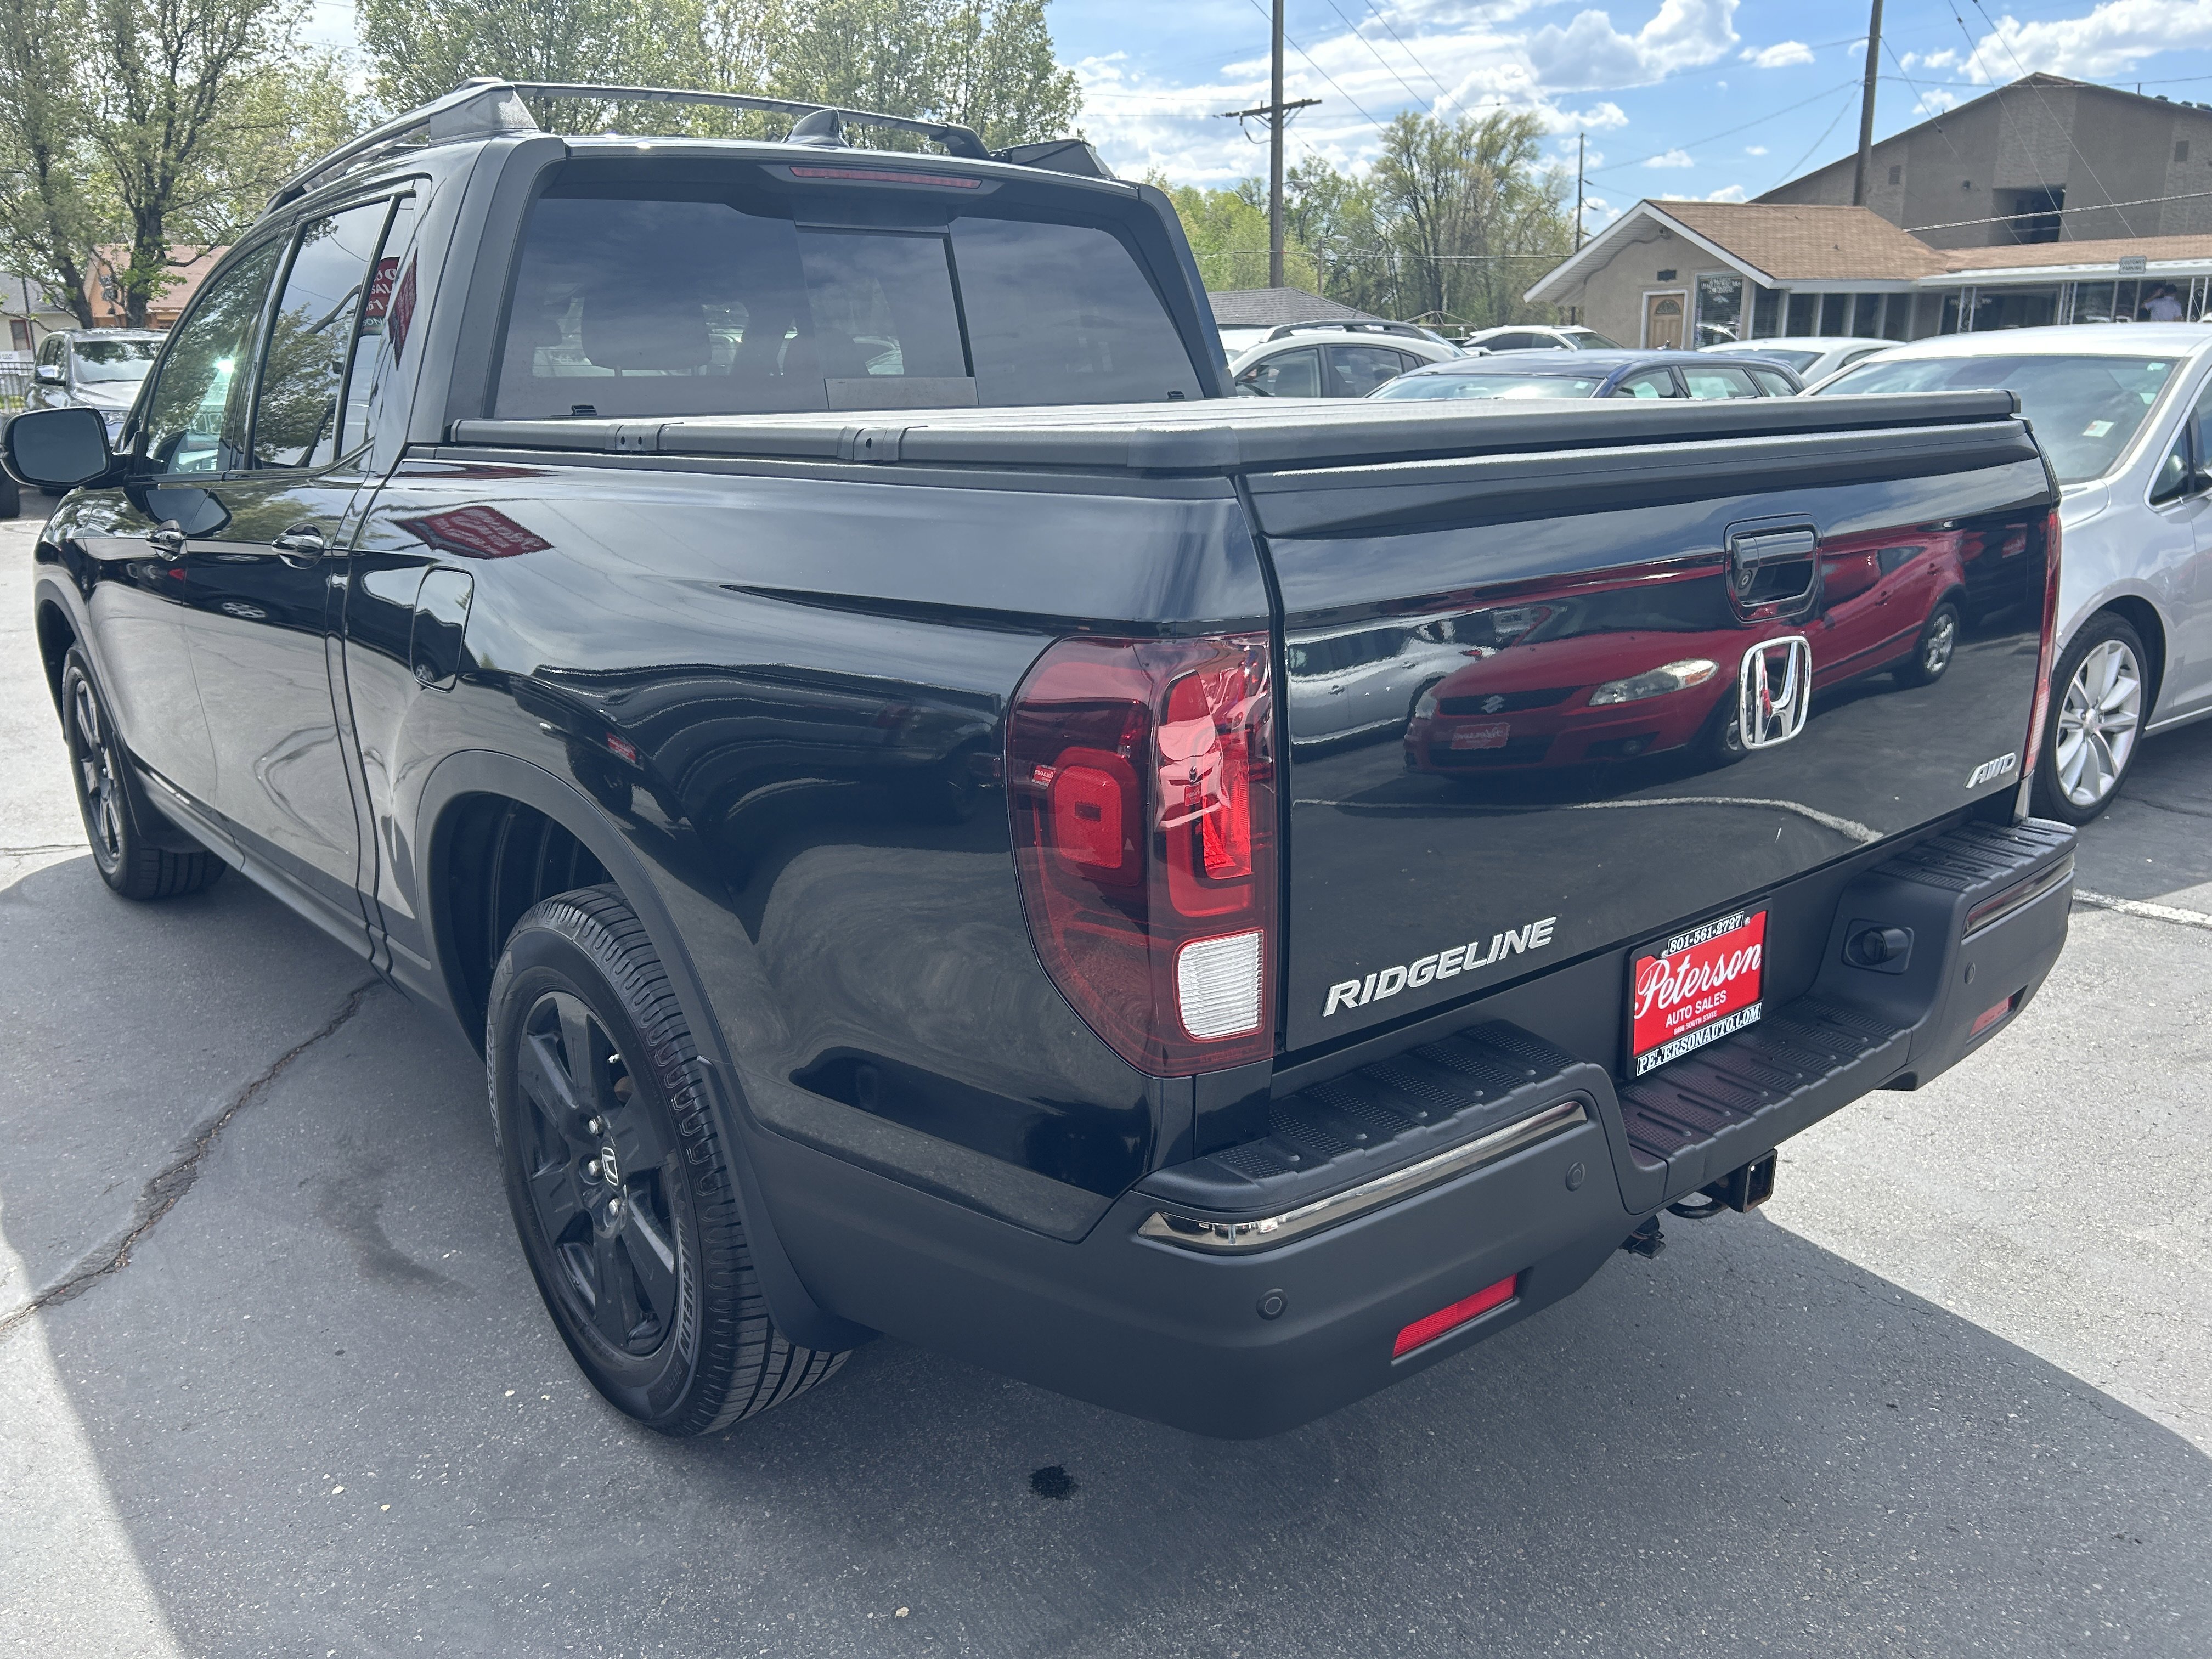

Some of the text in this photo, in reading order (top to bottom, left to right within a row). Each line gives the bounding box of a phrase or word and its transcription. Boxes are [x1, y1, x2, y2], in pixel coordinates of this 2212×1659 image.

[1965, 752, 2016, 789] AWD
[1669, 913, 1743, 953] 801-561-2727
[1322, 916, 1557, 1017] RIDGELINE
[1634, 943, 1762, 1019] Peterson
[1665, 990, 1726, 1028] AUTO SALES
[1685, 1017, 1702, 1030] SOUTH
[1702, 1009, 1717, 1022] STATE
[678, 1219, 693, 1356] MICHELIN
